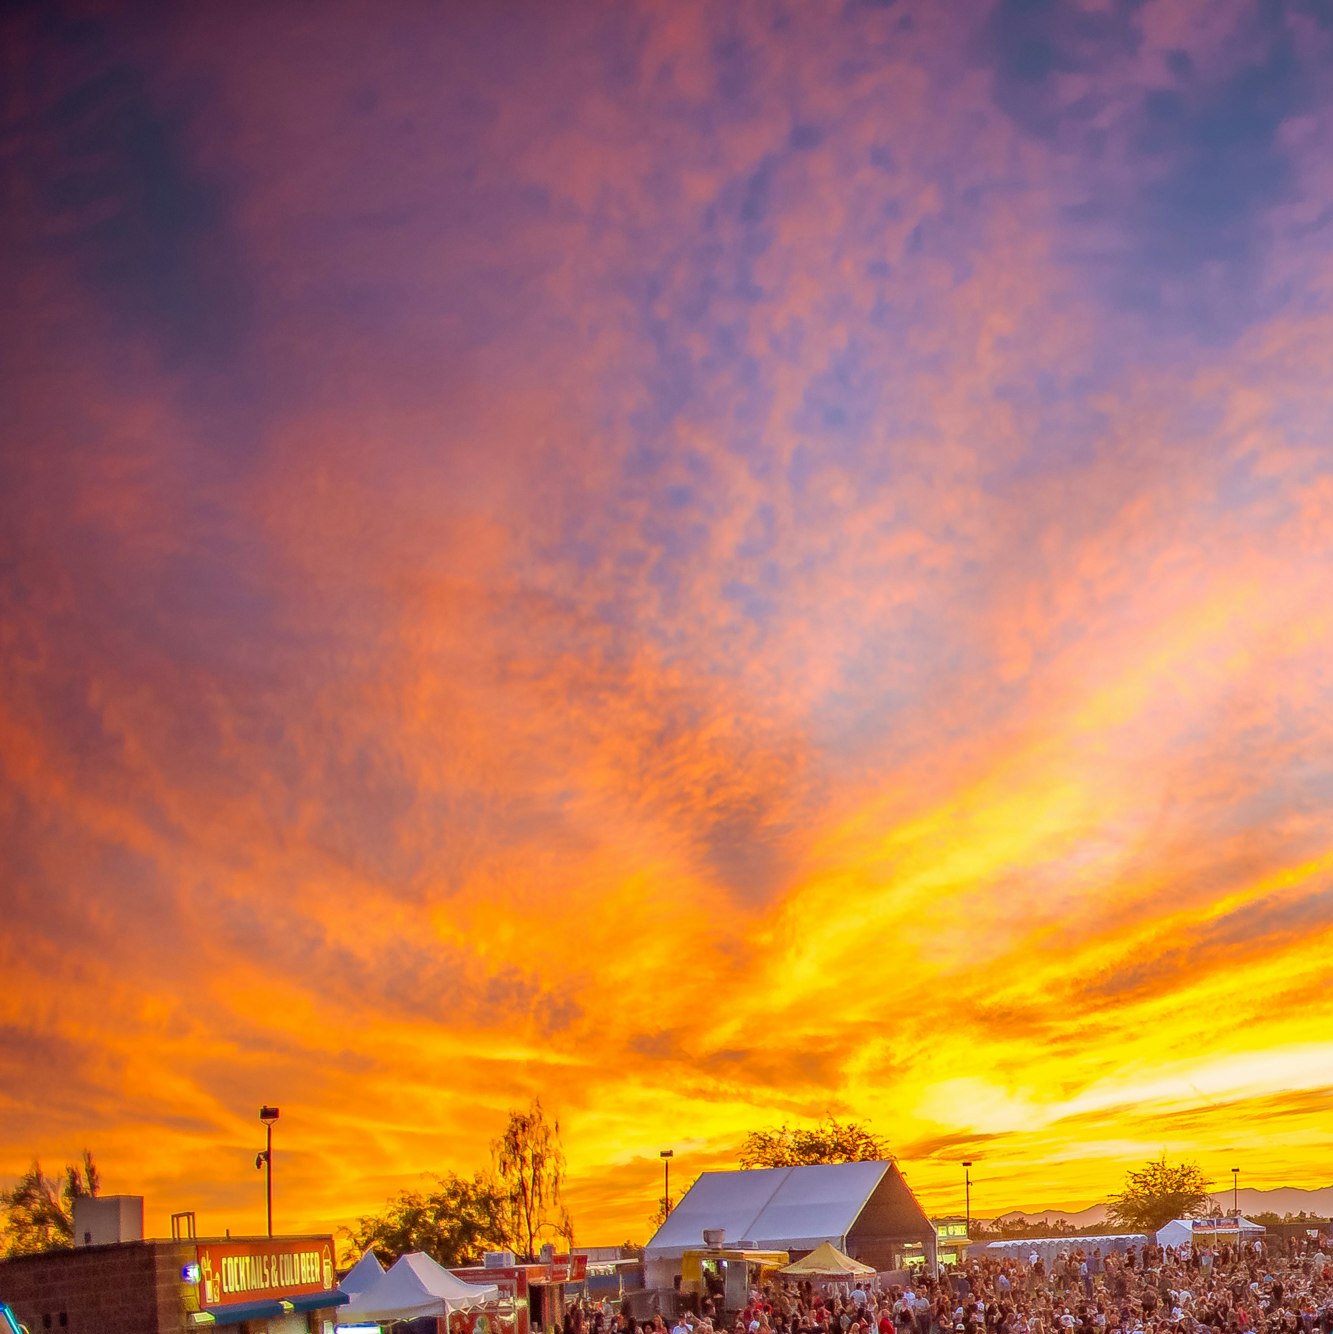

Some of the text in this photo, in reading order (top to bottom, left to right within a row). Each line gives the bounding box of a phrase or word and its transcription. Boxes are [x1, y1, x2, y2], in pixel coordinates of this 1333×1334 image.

[221, 1252, 320, 1293] COCKTAILS & COLD BEER
